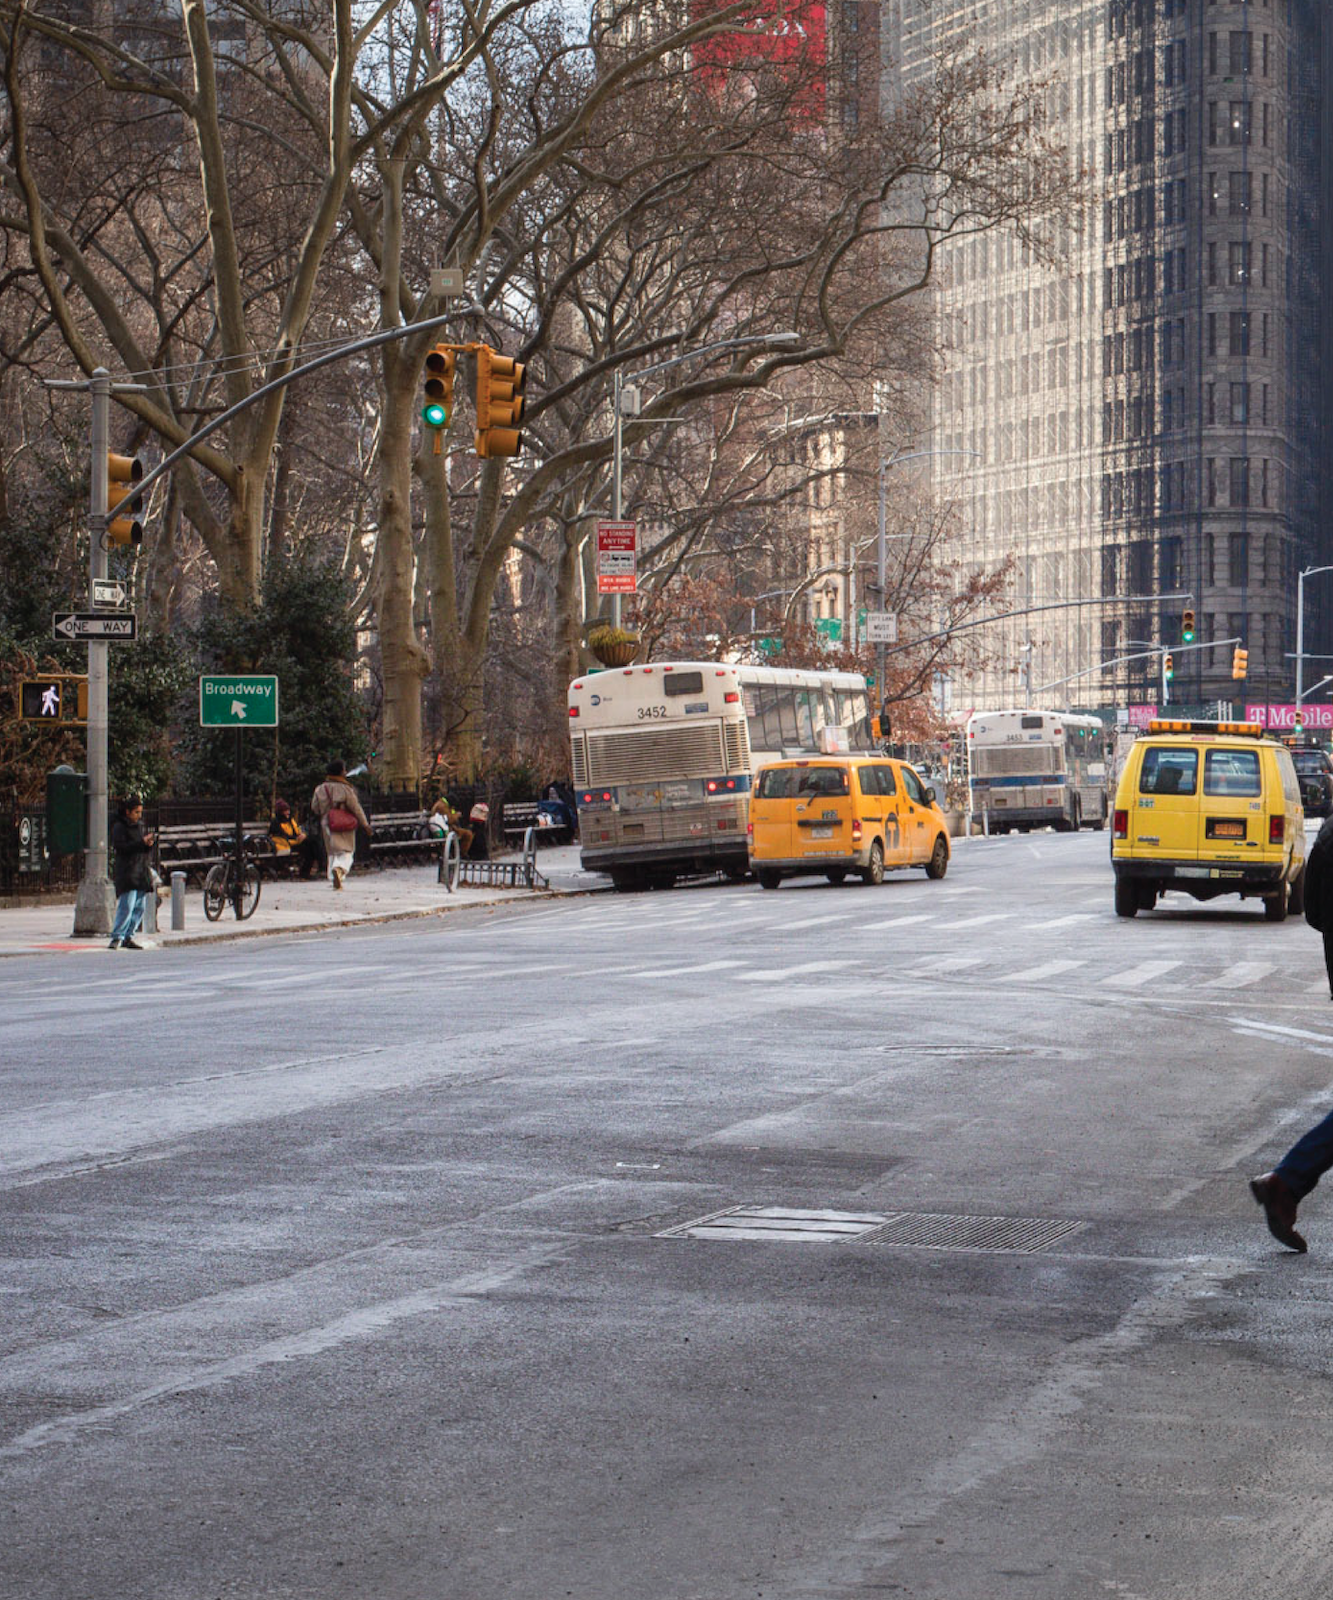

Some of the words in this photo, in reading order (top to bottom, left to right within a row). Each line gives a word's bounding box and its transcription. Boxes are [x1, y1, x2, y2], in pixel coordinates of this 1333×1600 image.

[65, 621, 90, 633] ONE
[102, 621, 129, 632] WAY
[205, 682, 272, 697] Broadway
[637, 705, 668, 720] 3452
